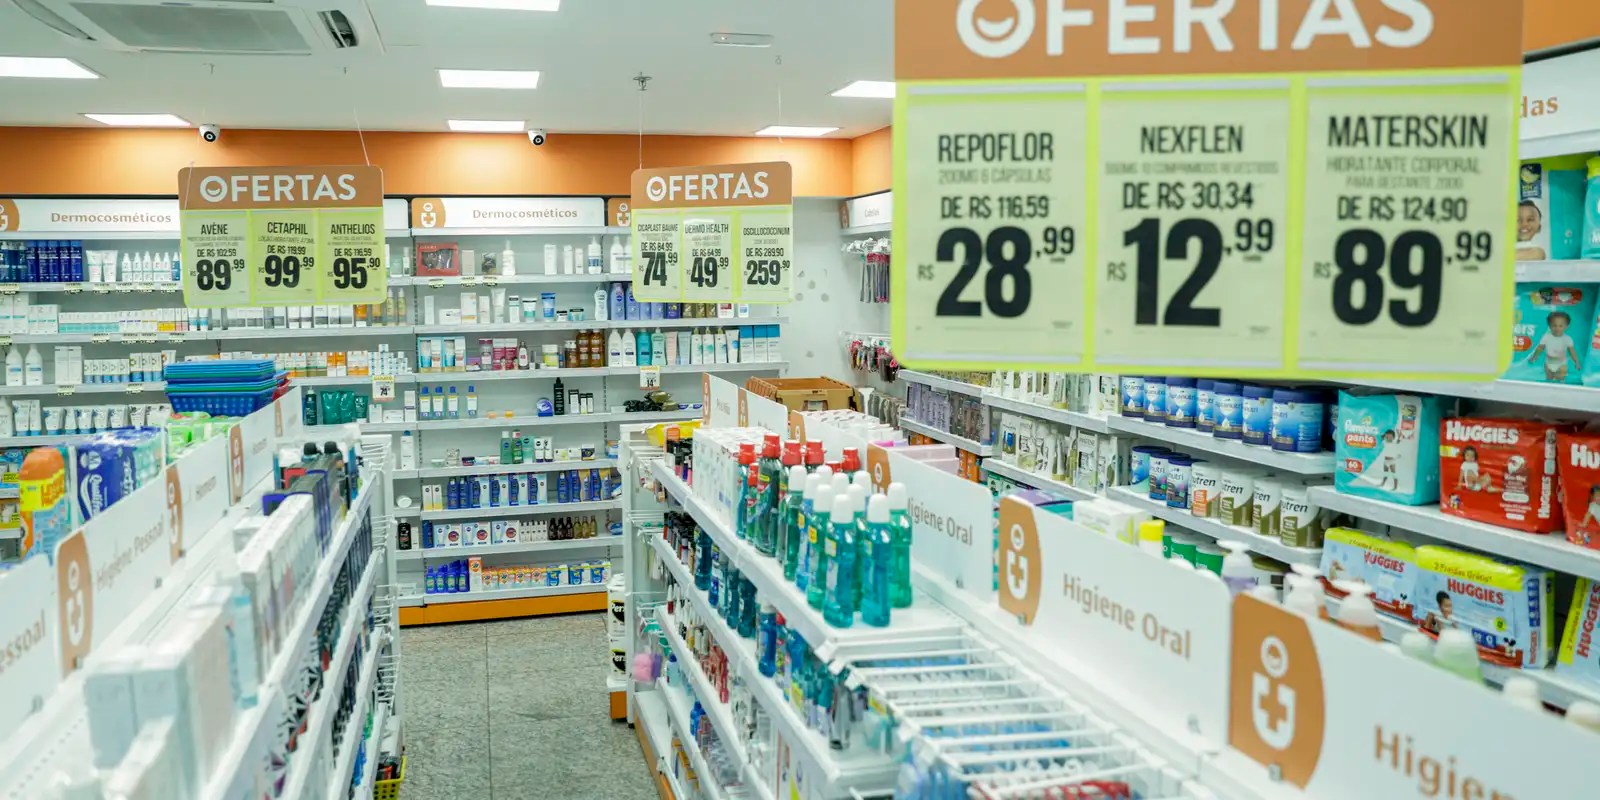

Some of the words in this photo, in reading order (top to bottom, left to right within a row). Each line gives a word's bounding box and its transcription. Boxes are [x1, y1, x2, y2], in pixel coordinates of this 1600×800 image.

[956, 0, 1434, 58] OFERTAS
[1141, 126, 1243, 153] NEXFLEN
[1328, 115, 1488, 148] MATERSKIN
[938, 133, 1054, 163] REPOFLOR
[200, 174, 357, 203] OFERTAS
[646, 171, 769, 202] OFERTAS
[1123, 182, 1150, 210] DE
[1192, 182, 1254, 211] 30,34
[51, 212, 172, 223] Dermocosméticos
[473, 209, 578, 219] Dermocosméticos
[941, 196, 963, 218] DE
[998, 195, 1049, 220] 116,59
[1337, 195, 1362, 221] DE
[1403, 195, 1468, 223] 124,90
[267, 222, 309, 235] CETAPHIL
[331, 223, 375, 235] ANTHELIOS
[706, 224, 729, 233] HEALTH
[197, 249, 205, 257] DE
[267, 245, 276, 254] DE
[334, 248, 342, 256] DE
[641, 242, 649, 251] DE
[746, 248, 753, 256] DE
[1347, 433, 1375, 445] pants
[1446, 421, 1519, 445] HUGGIES
[947, 516, 973, 547] Oral
[1447, 577, 1505, 605] HUGGIES
[1063, 572, 1135, 632] Higiene
[1142, 612, 1191, 662] Oral
